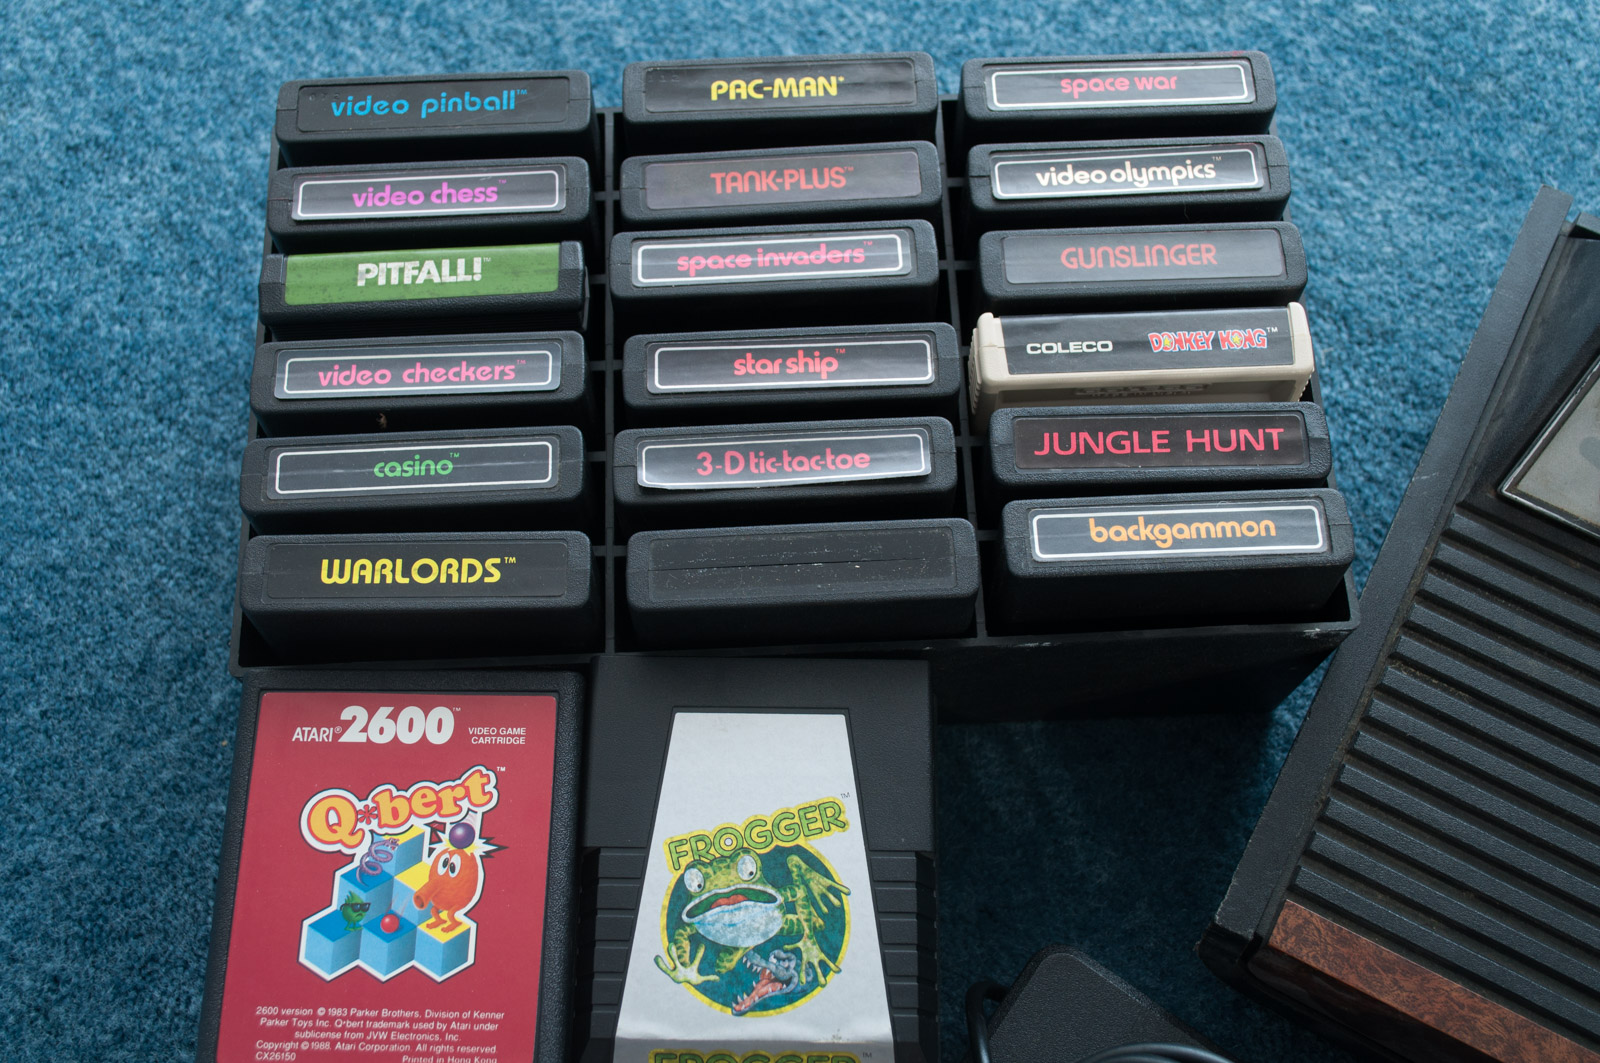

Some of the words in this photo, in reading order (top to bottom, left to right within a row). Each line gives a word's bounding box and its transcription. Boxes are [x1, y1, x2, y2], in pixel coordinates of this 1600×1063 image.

[1061, 79, 1130, 99] space
[1134, 75, 1177, 91] war
[331, 96, 410, 117] video
[421, 90, 516, 118] pinball
[710, 167, 846, 194] TANK-PLUS
[1036, 164, 1108, 187] video
[1110, 160, 1216, 188] olympics
[352, 184, 425, 207] video
[430, 182, 498, 205] chess
[677, 252, 752, 277] space
[757, 244, 865, 267] invaders
[1061, 243, 1217, 270] GUNSLINGER
[357, 257, 482, 287] PITFALL!
[1026, 340, 1113, 355] COLECO
[1148, 330, 1214, 353] DONKEY
[1218, 328, 1268, 350] KONG
[319, 364, 392, 387] video
[402, 361, 516, 384] checkers
[734, 353, 783, 377] star
[786, 350, 839, 380] ship
[1034, 430, 1171, 456] JUNGLE
[1186, 428, 1284, 452] HUNT
[373, 455, 454, 478] casino
[696, 451, 745, 476] 3-D
[750, 449, 870, 474] tic-tac-toe
[1089, 516, 1276, 549] backgammon
[320, 558, 501, 585] WARLORDS
[338, 706, 455, 745] 2600
[468, 727, 498, 735] VIDEO
[499, 727, 527, 736] GAME
[471, 736, 526, 745] CARTRIDGE
[667, 800, 847, 871] FROGGER
[255, 1006, 279, 1015] 2600
[281, 1007, 313, 1016] version
[328, 1008, 348, 1016] 1983
[350, 1008, 379, 1017] Parker
[424, 1009, 460, 1018] Division
[462, 1010, 471, 1019] of
[473, 1010, 505, 1019] Kenner
[259, 1017, 289, 1027] Parker
[292, 1018, 313, 1029] Toys
[366, 1019, 410, 1029] trademark
[412, 1021, 435, 1030] used
[436, 1021, 448, 1031] by
[449, 1021, 471, 1030] Atari
[473, 1022, 499, 1031] under
[256, 1040, 299, 1051] Copyright
[335, 1041, 356, 1051] Atari
[415, 1043, 427, 1052] All
[429, 1044, 454, 1054] rights
[294, 1030, 342, 1039] sublicense
[344, 1031, 364, 1039] from
[366, 1031, 388, 1040] JVW
[255, 1051, 296, 1061] CX26150
